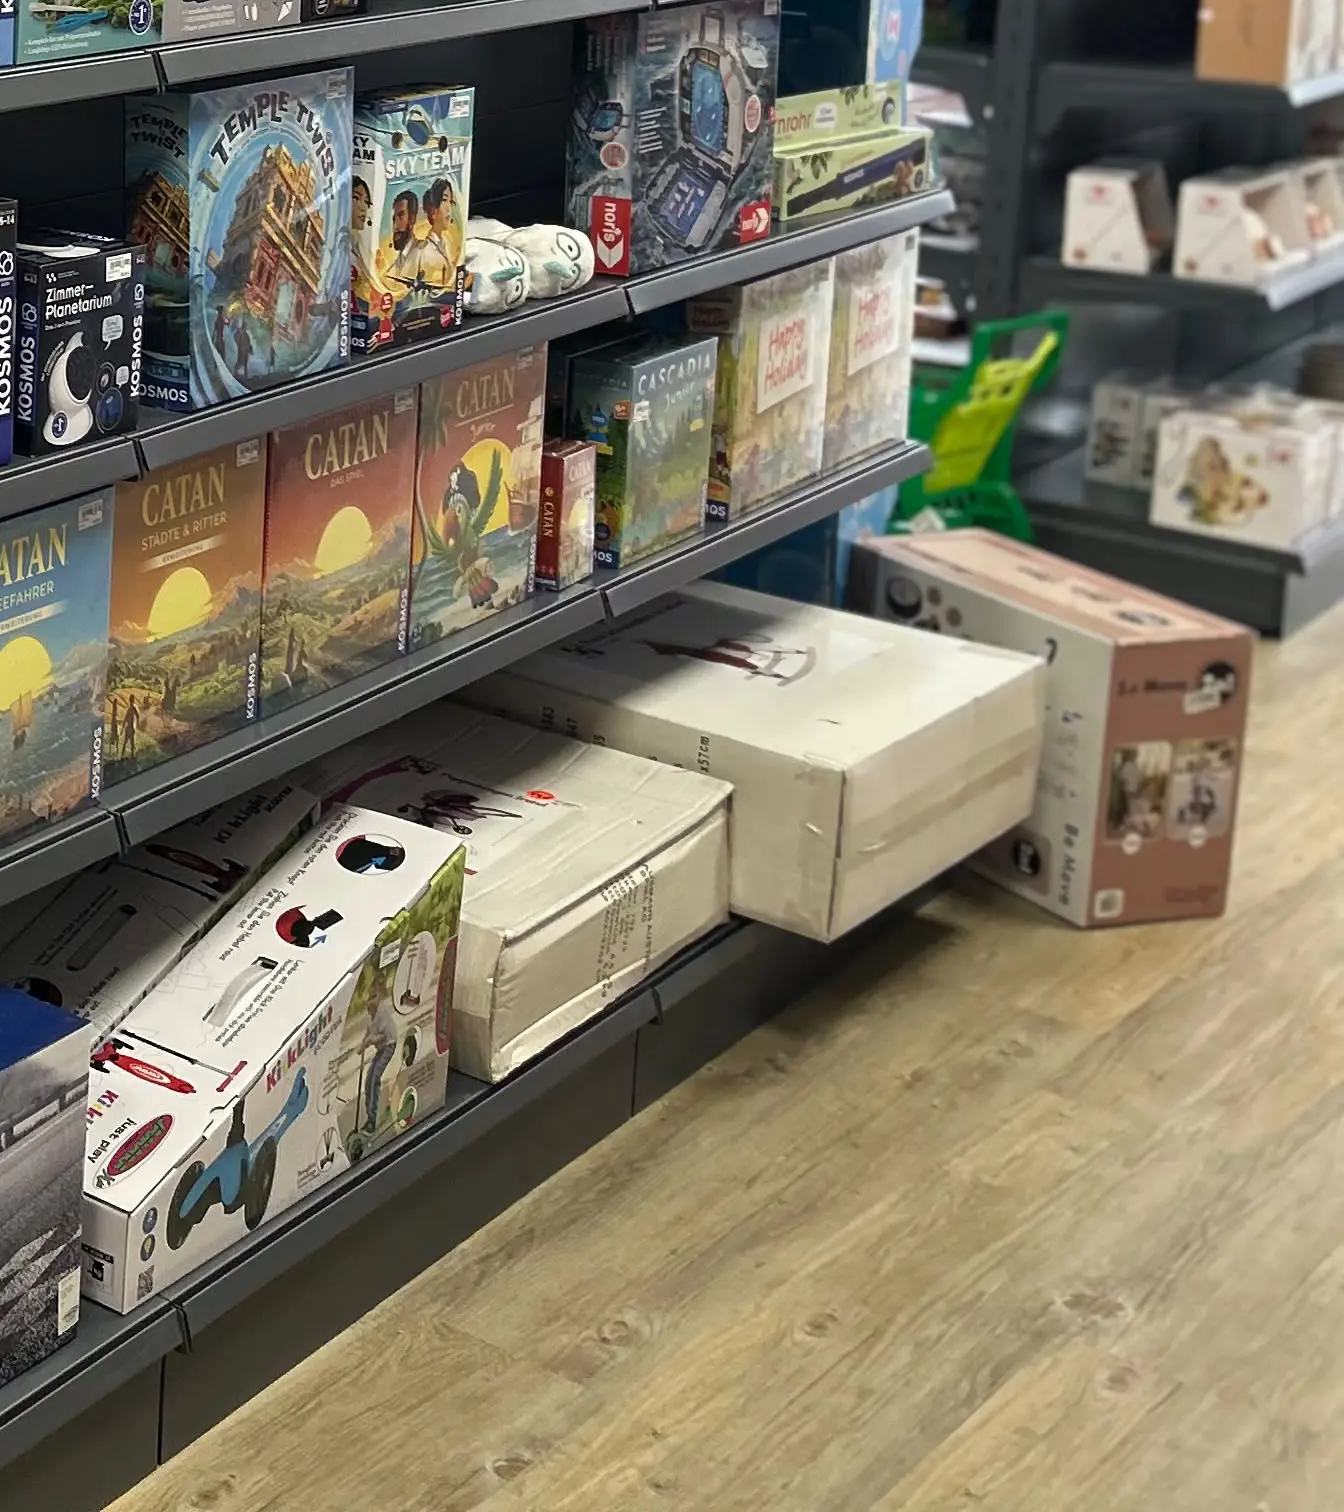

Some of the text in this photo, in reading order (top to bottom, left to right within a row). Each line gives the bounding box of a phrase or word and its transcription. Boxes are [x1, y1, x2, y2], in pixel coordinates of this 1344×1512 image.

[210, 89, 338, 201] TEMPLE TWIST
[385, 144, 466, 179] SKY TEAM
[604, 202, 617, 243] noris
[45, 294, 113, 320] Planetarium
[767, 318, 806, 361] Happy
[455, 366, 515, 420] CATAN
[637, 352, 711, 396] CASCADIA
[304, 411, 390, 480] CATAN
[142, 463, 226, 527] CATAN
[141, 510, 228, 552] STÄDTE & RITTER
[700, 735, 710, 773] x57cm
